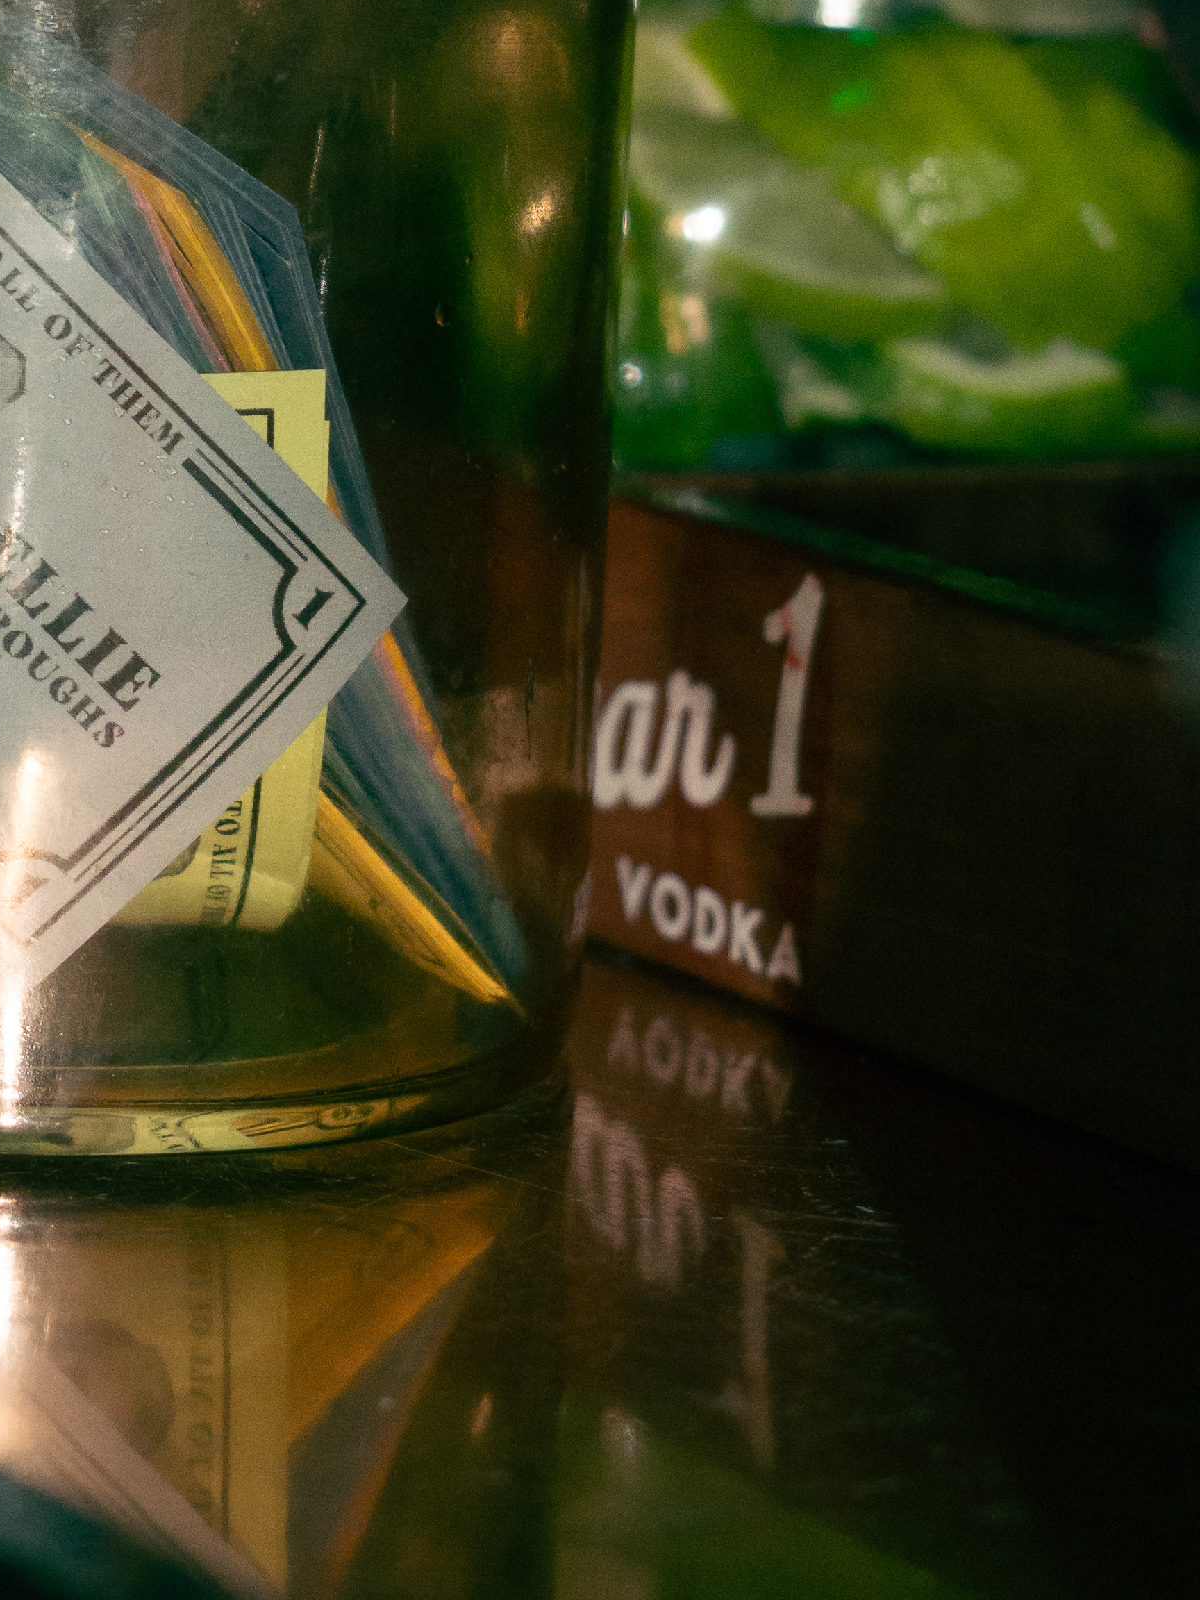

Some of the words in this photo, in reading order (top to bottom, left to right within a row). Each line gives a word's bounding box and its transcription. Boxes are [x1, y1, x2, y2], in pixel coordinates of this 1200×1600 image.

[43, 314, 95, 356] OF
[92, 358, 184, 455] THEM
[292, 588, 335, 632] 1
[750, 572, 826, 818] 1
[615, 853, 801, 988] VODKA
